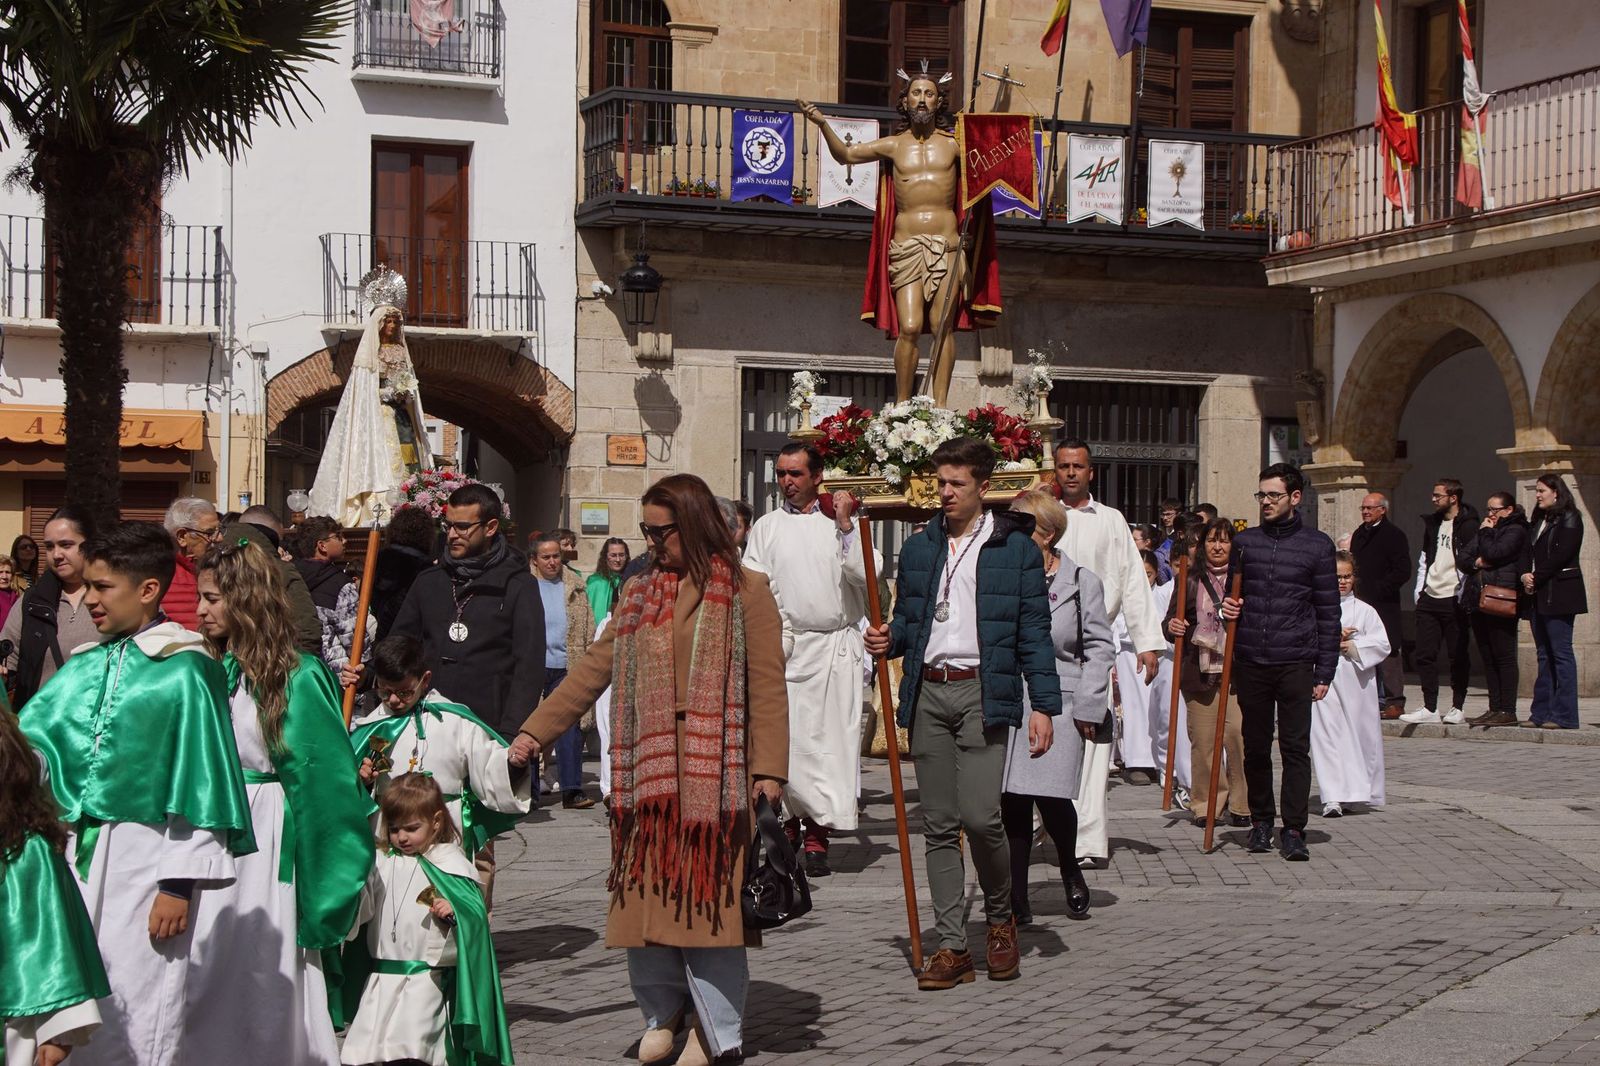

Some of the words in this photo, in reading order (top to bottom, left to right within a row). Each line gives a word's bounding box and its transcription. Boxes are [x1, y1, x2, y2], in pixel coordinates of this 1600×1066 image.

[968, 127, 1031, 178] ALELUYA
[756, 178, 790, 187] NAZARENO
[616, 445, 638, 453] PLAZA
[616, 453, 638, 461] MAYOR
